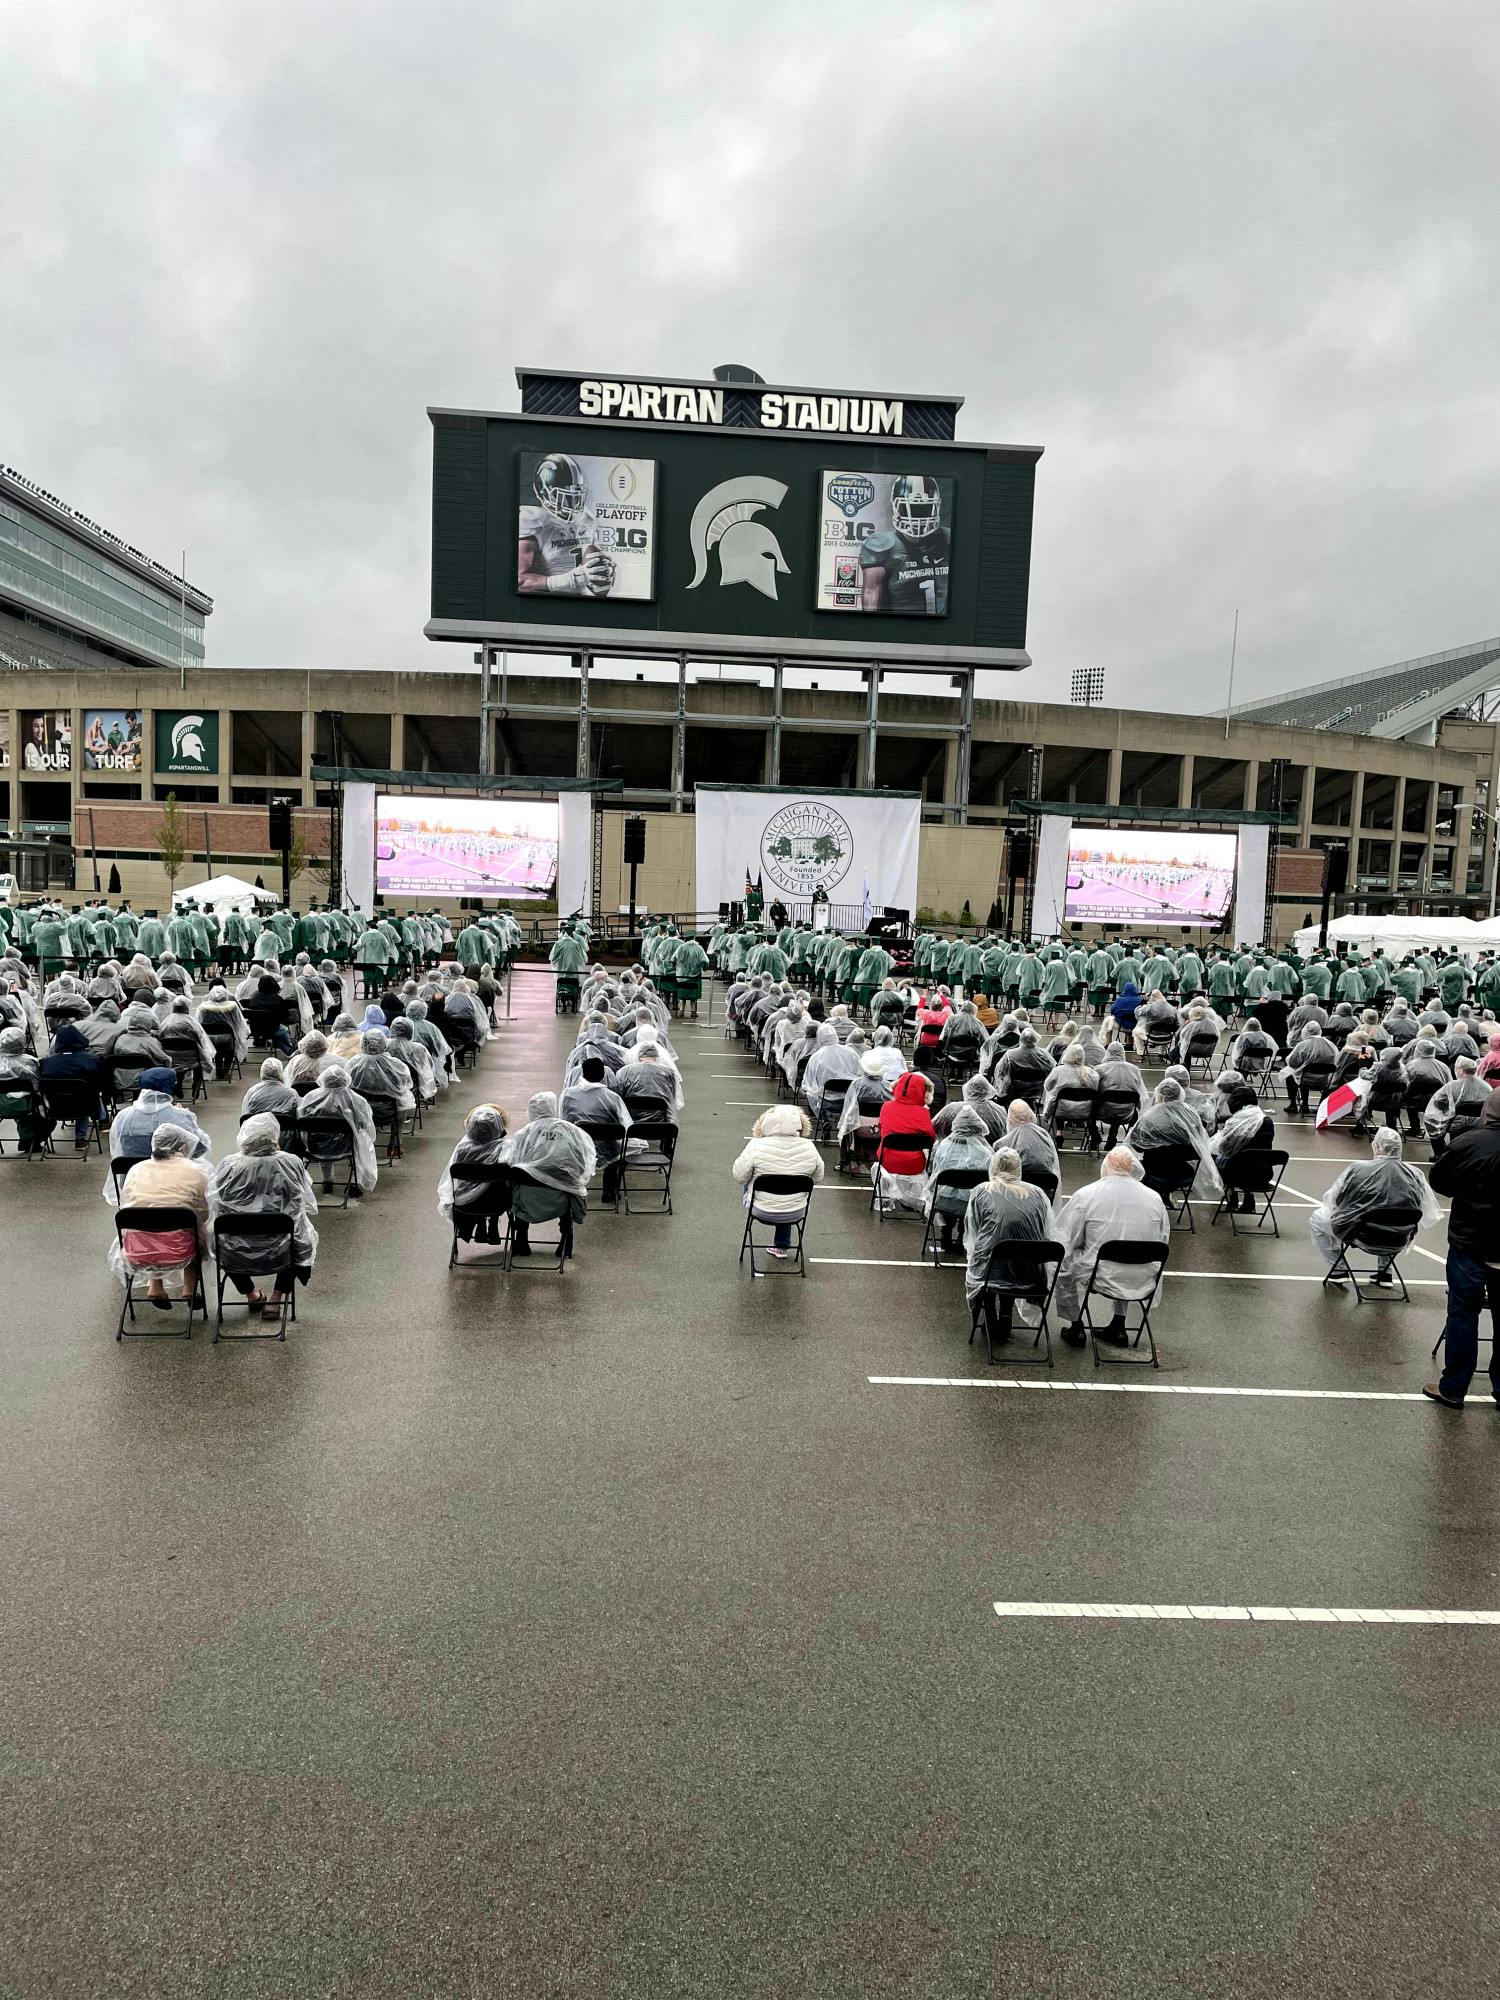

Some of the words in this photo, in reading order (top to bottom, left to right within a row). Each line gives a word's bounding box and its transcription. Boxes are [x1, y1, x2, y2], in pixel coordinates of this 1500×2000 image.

[579, 381, 724, 424] SPARTAN
[760, 393, 904, 435] STADIUM
[831, 485, 871, 500] COTTON
[839, 494, 864, 503] BOWL
[596, 509, 647, 520] PLAYOFF
[899, 567, 934, 580] MICHIGAN
[27, 753, 39, 768] IS
[40, 753, 70, 768] OUR
[95, 754, 135, 769] TURF.
[766, 805, 820, 842] MICHIGAN
[825, 811, 849, 844] STATE
[770, 866, 841, 893] UNIVERITY
